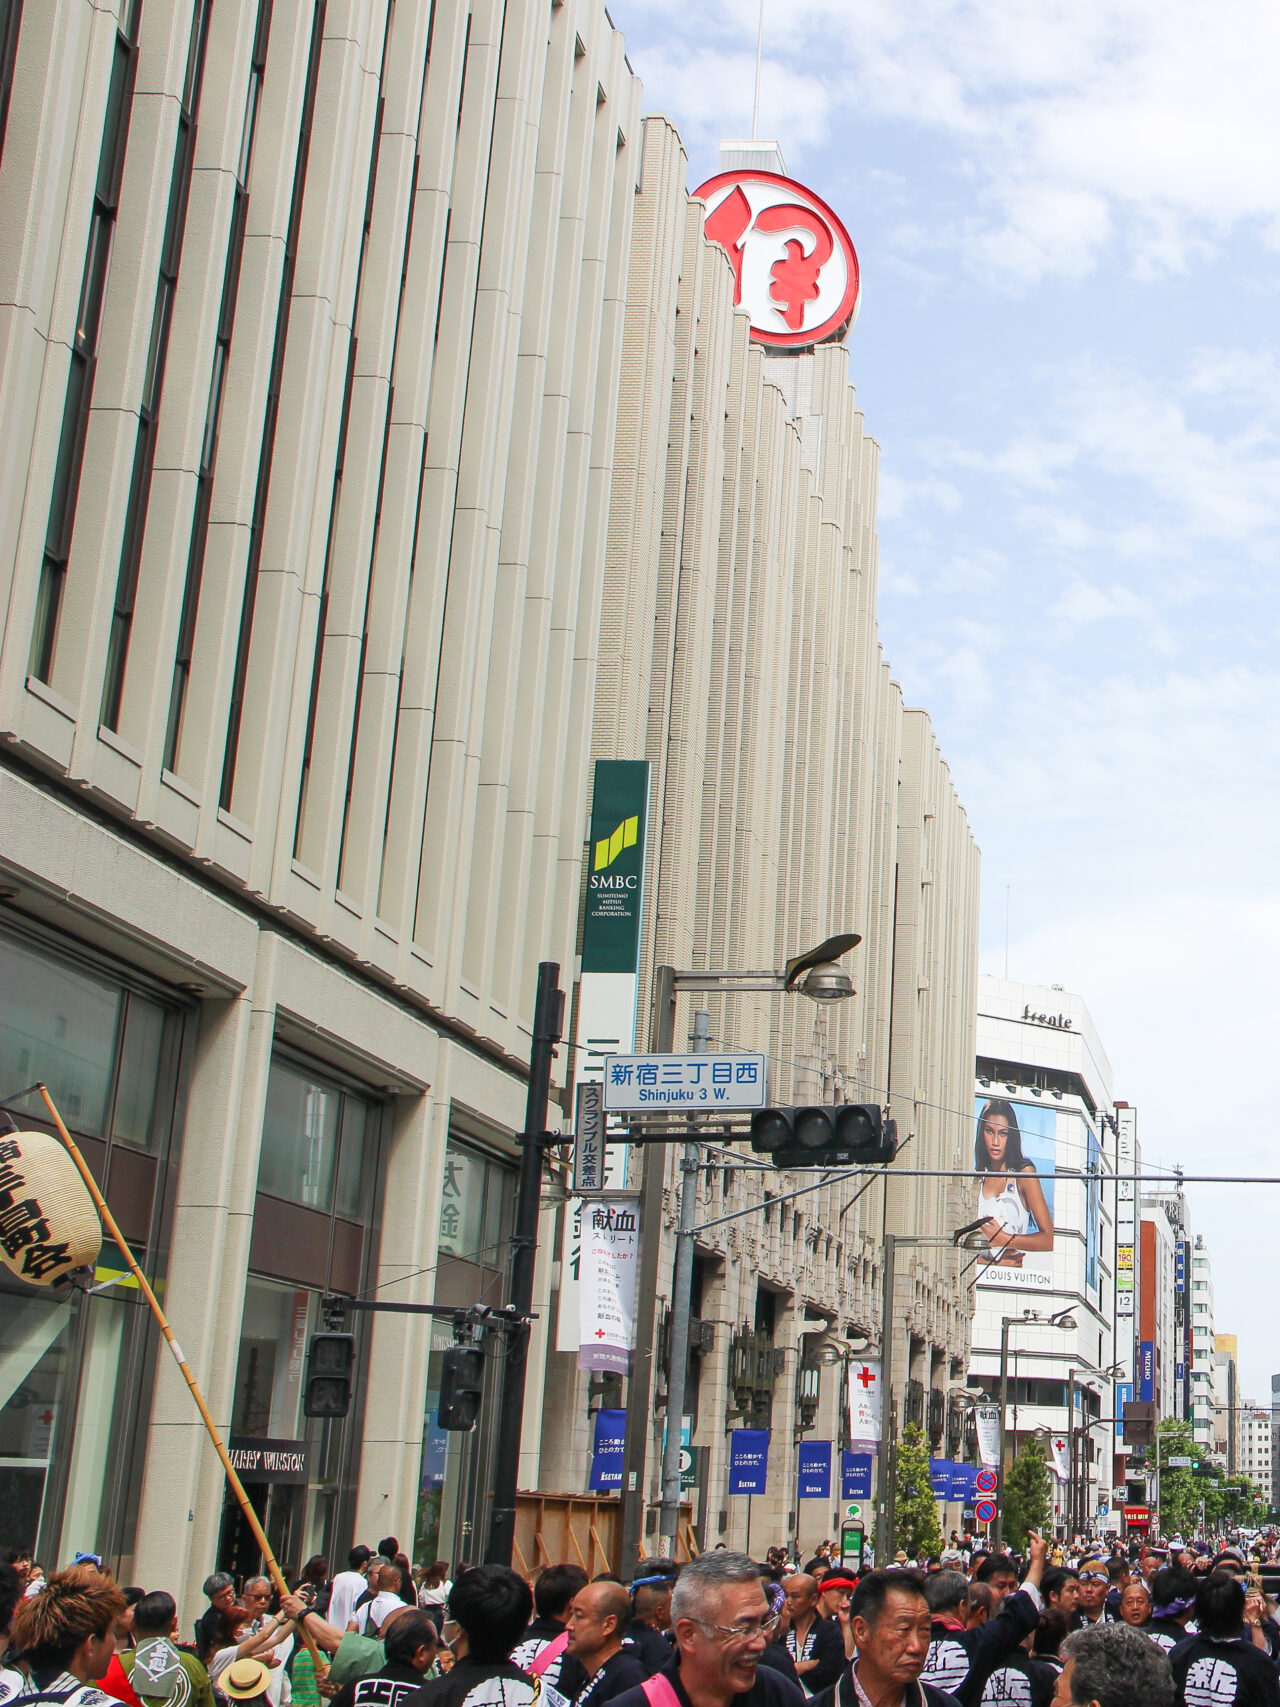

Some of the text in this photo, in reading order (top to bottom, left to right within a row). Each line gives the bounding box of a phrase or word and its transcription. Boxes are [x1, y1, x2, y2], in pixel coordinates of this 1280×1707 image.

[590, 875, 637, 889] SMBC
[611, 1062, 759, 1086] 新宿三丁目西
[639, 1087, 730, 1103] Shinjuku 3 W.
[582, 1087, 599, 1187] スクランブル交差点
[591, 1208, 636, 1232] 献血
[592, 1232, 635, 1244] ストリート
[985, 1270, 1051, 1284] LOUIS VUITTON
[1144, 1350, 1152, 1380] MIZUHO
[263, 1451, 305, 1472] WINSTON
[738, 1480, 756, 1488] ISETAN
[805, 1485, 822, 1493] ISETAN
